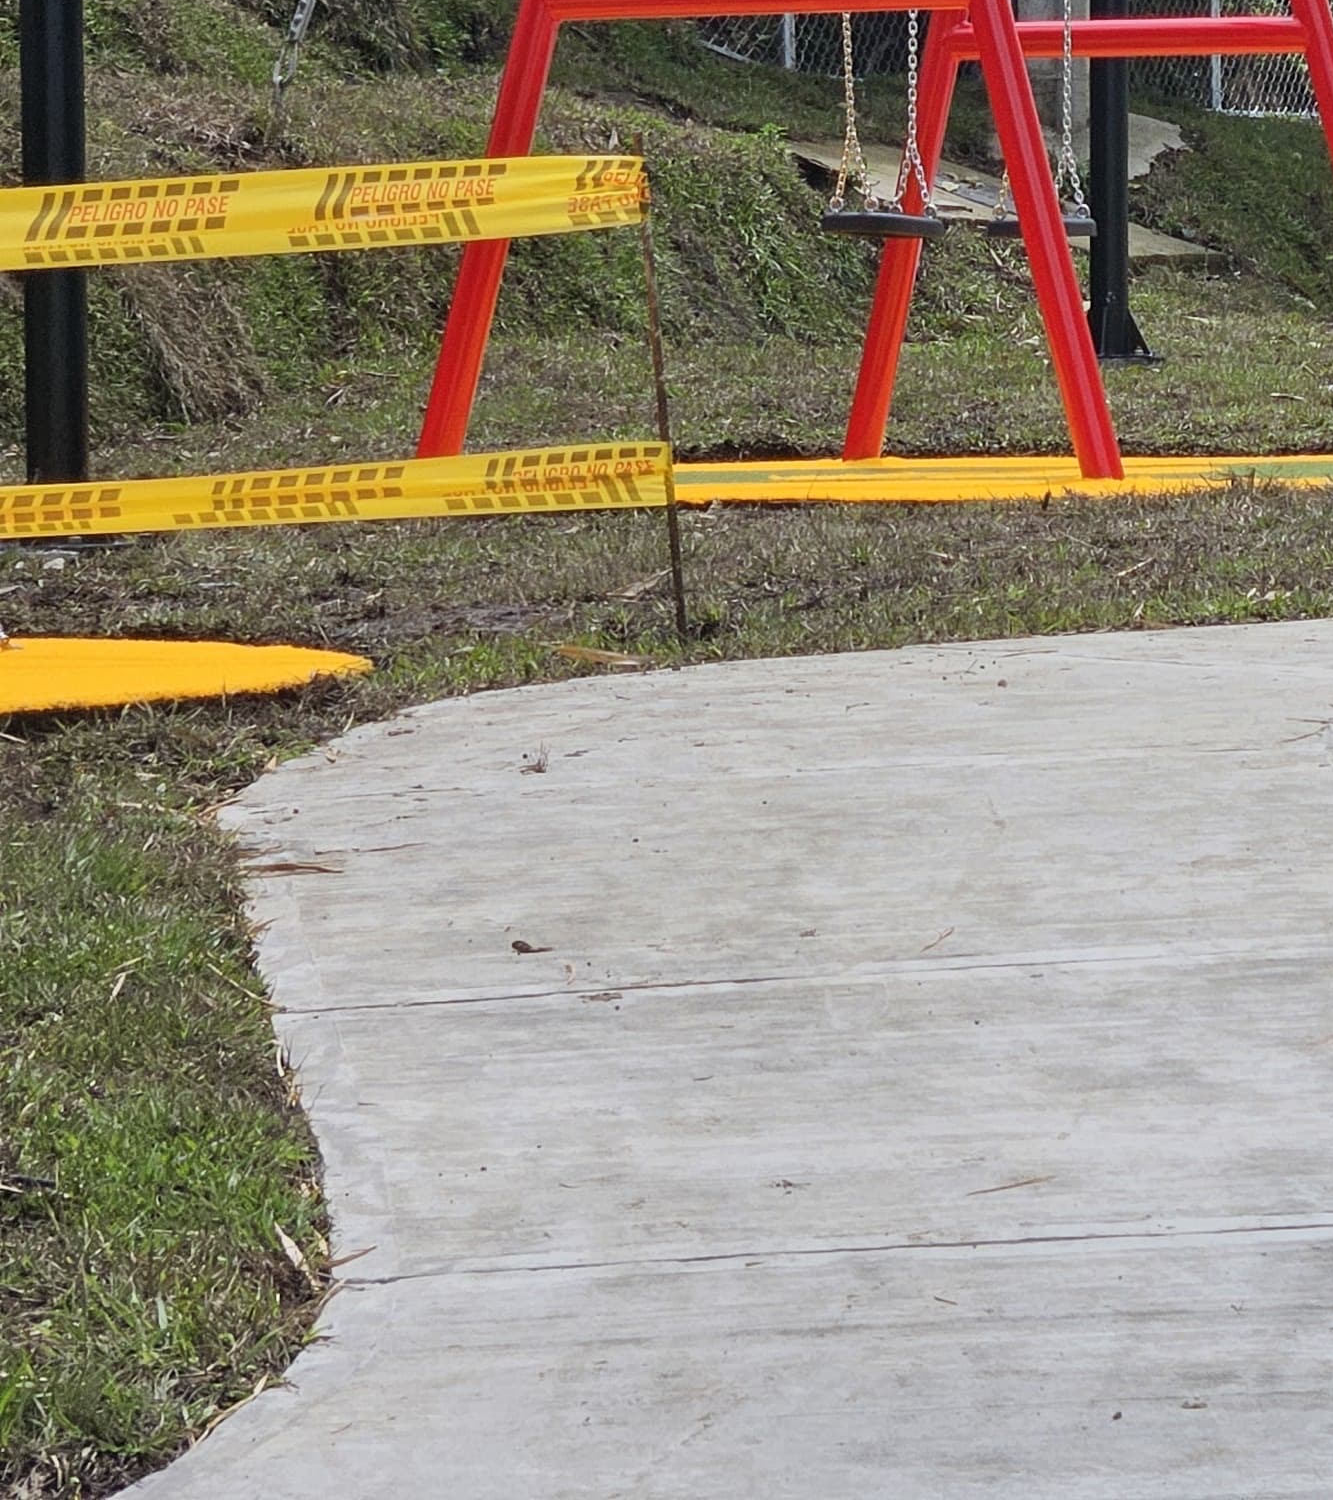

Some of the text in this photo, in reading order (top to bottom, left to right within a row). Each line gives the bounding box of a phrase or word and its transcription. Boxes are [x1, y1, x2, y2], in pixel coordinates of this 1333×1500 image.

[350, 178, 497, 204] PELIGRO NO PASE
[68, 196, 230, 223] PELIGRO NO PASE
